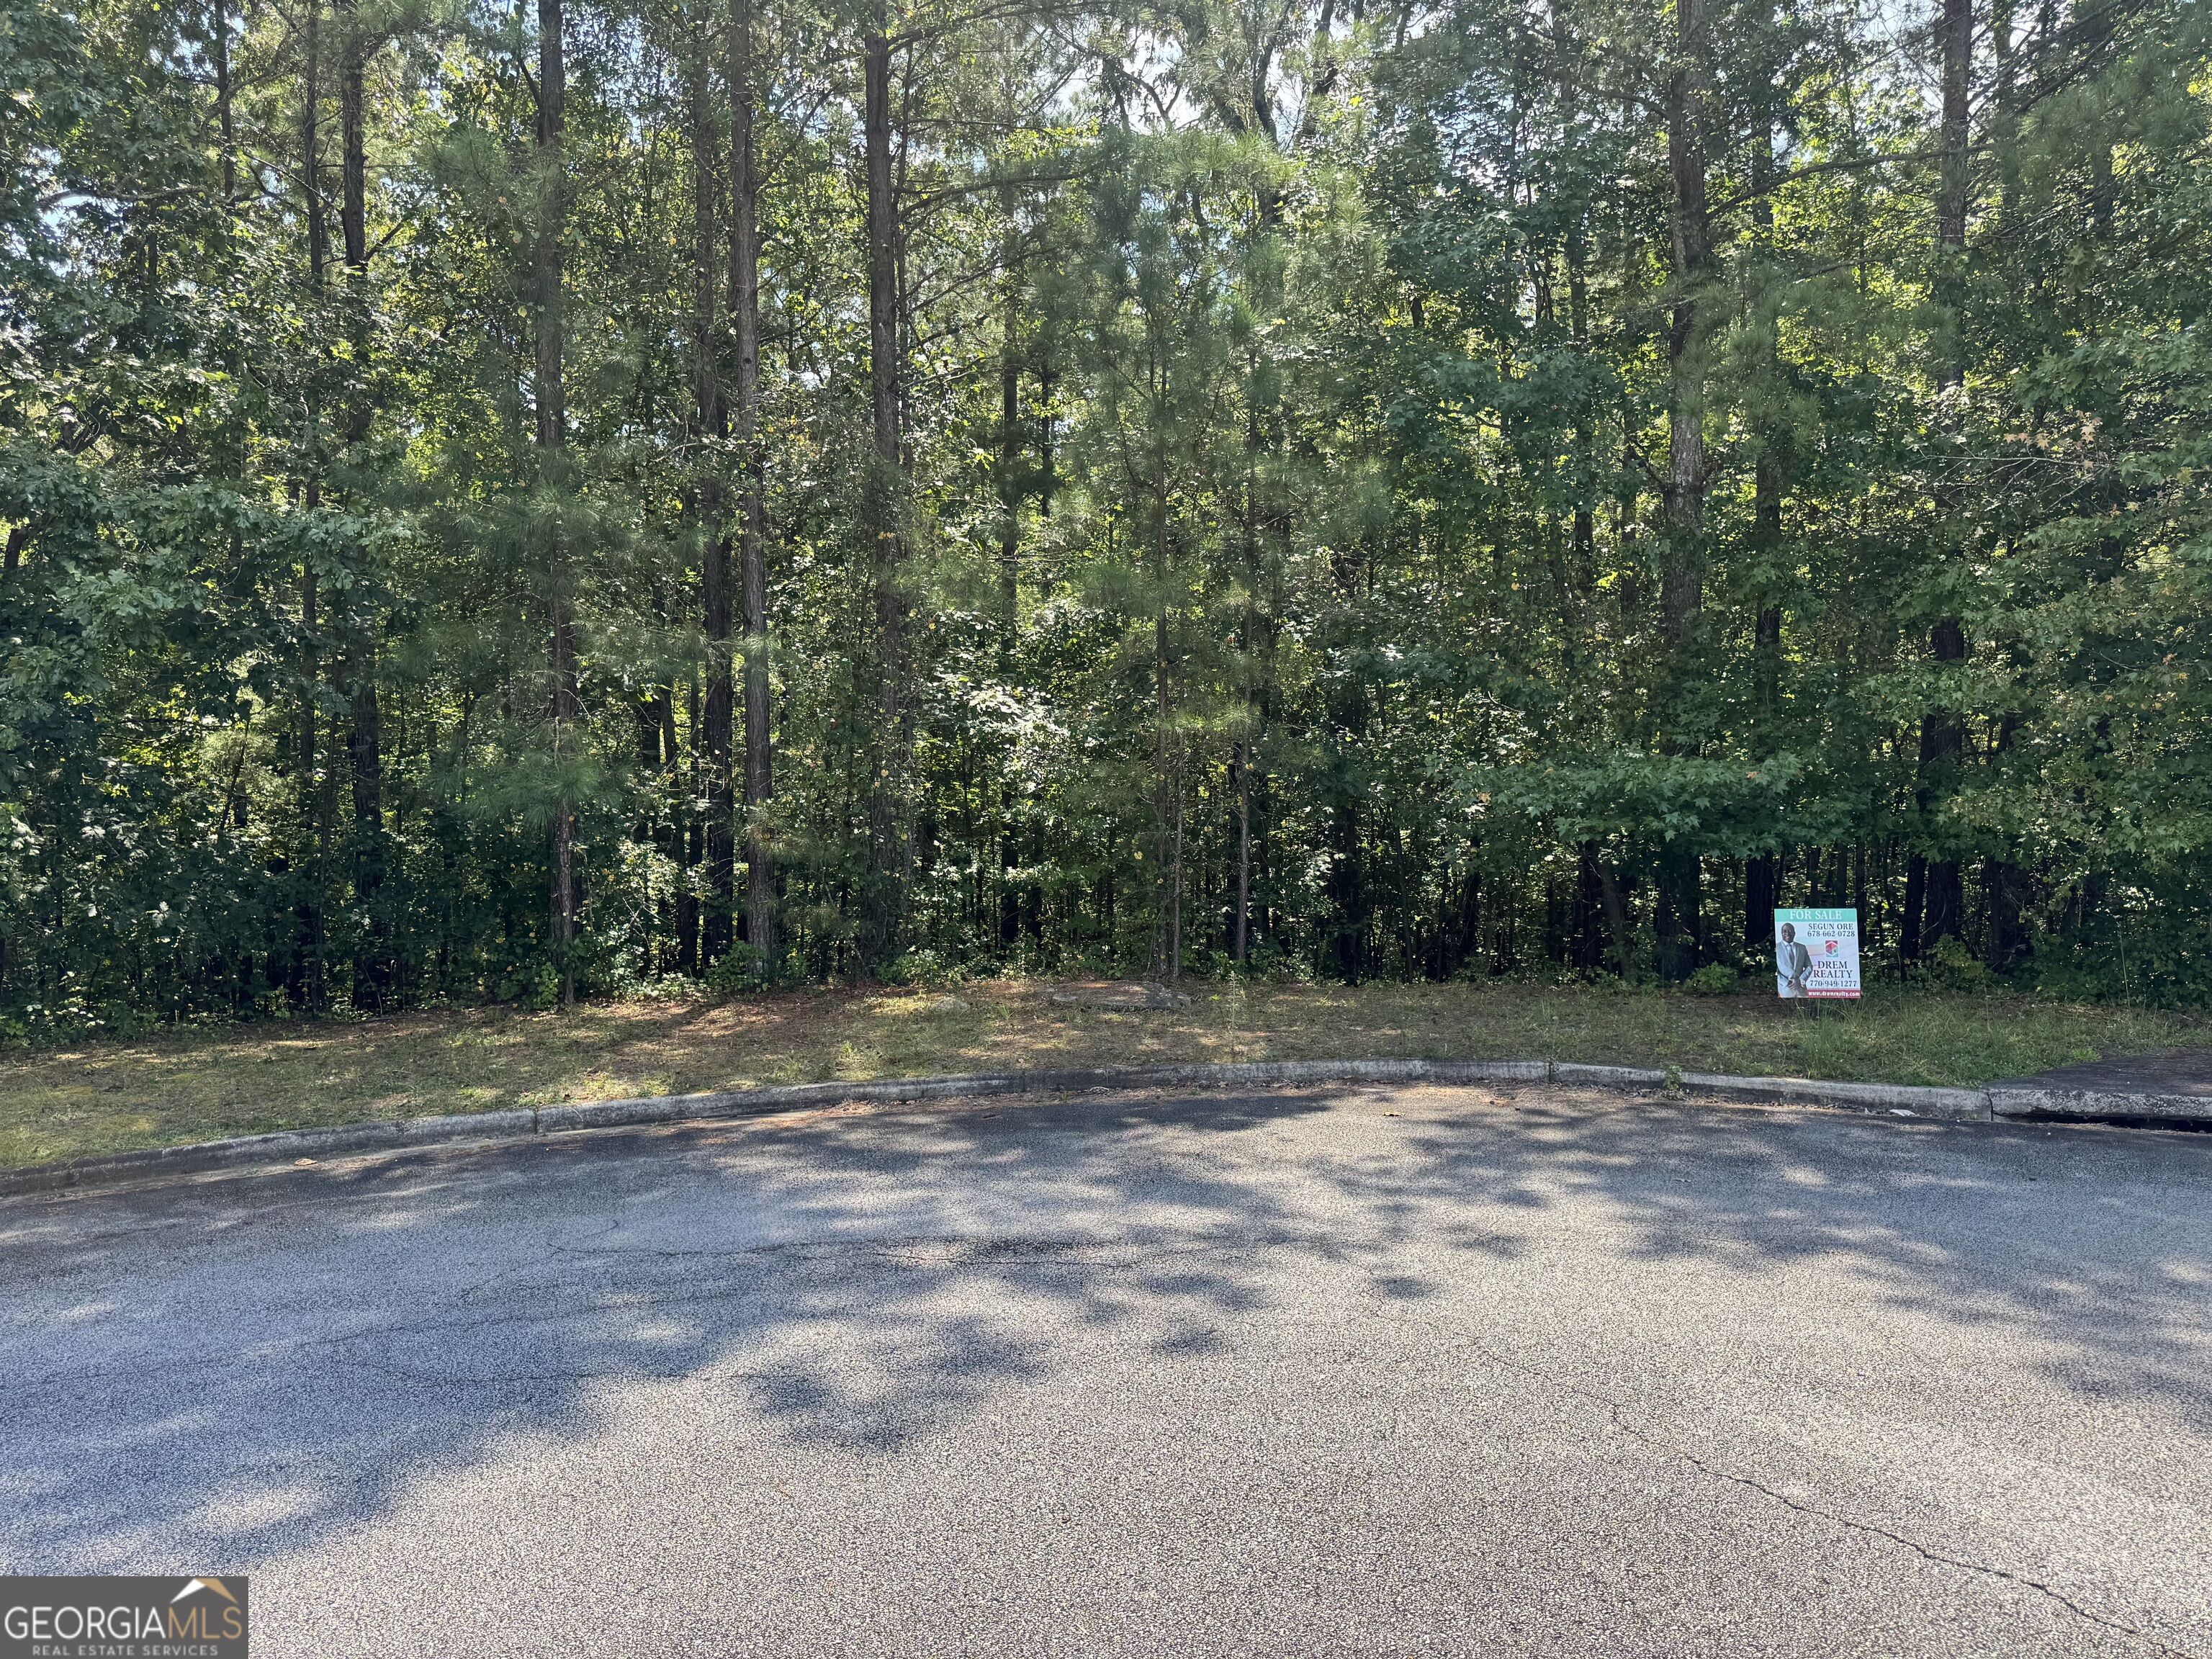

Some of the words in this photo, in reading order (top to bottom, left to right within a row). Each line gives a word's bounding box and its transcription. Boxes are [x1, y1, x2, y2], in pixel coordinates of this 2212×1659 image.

[1790, 910, 1812, 920] FOR
[1815, 910, 1842, 920] SALE
[1817, 961, 1848, 969] DREM
[1813, 970, 1853, 979] REALTY
